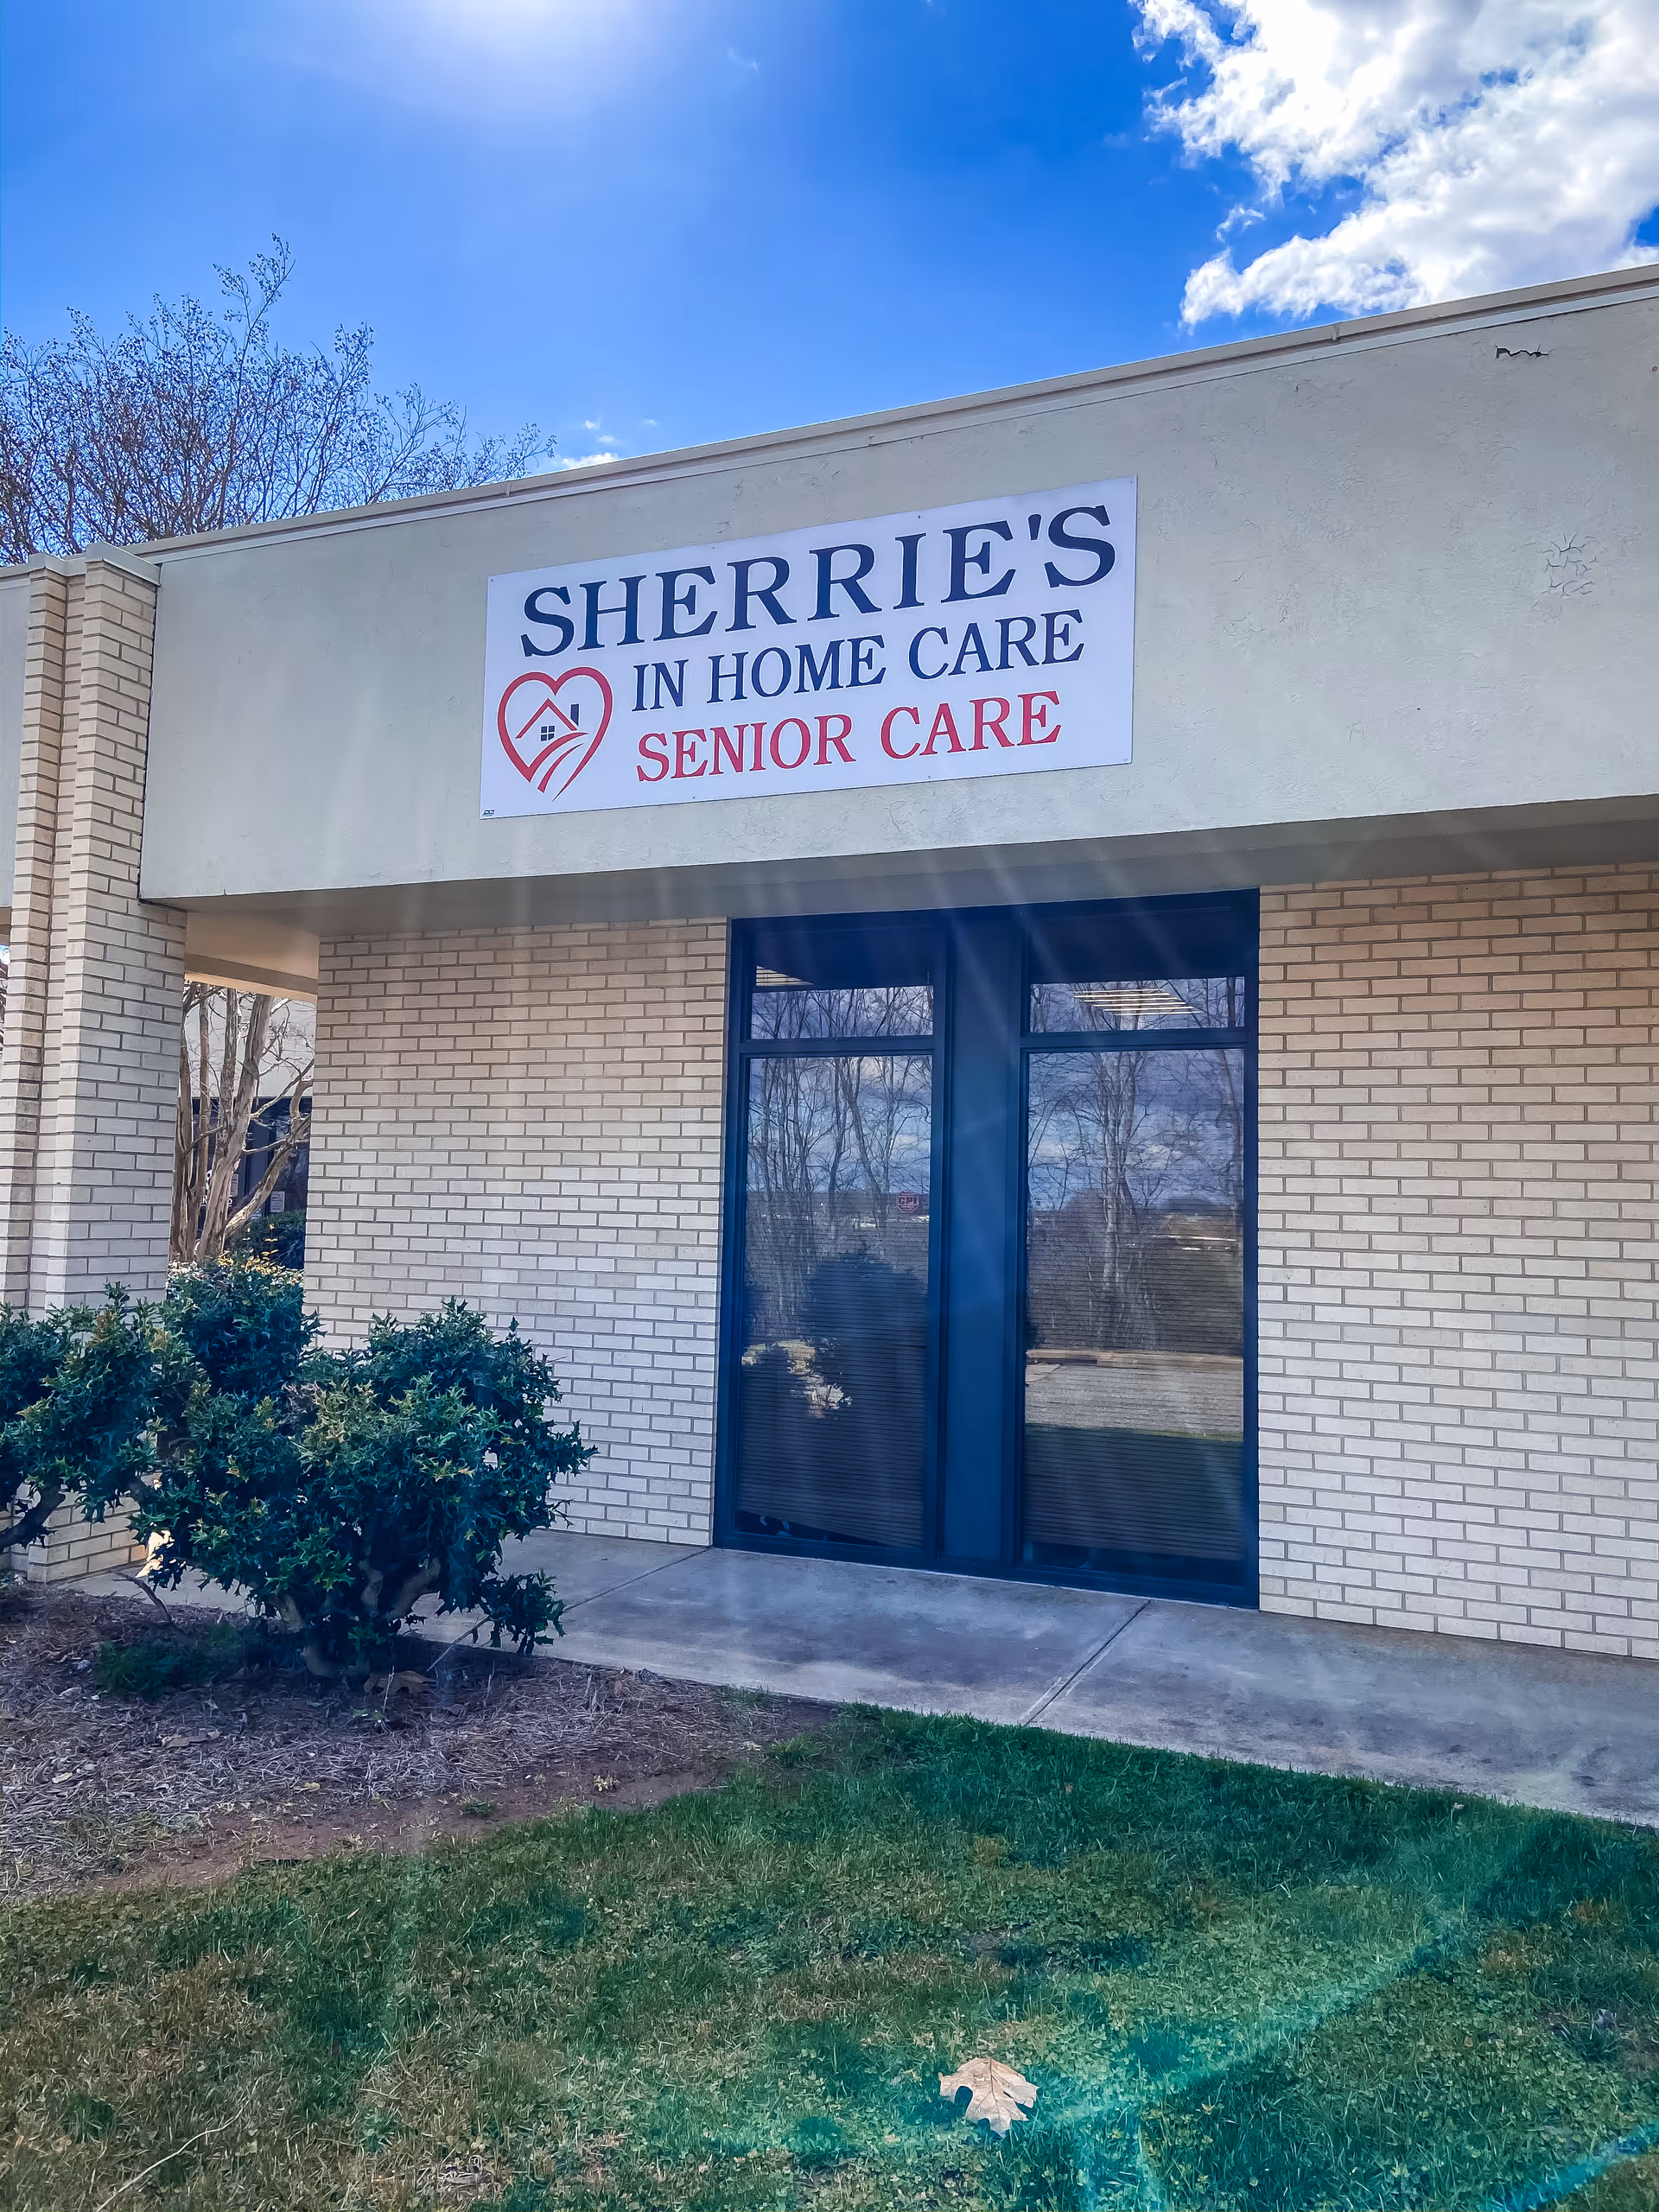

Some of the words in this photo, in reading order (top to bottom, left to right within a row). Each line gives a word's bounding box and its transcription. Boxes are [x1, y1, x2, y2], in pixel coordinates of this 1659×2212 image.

[520, 505, 1116, 658] SHERRIE'S
[632, 659, 690, 712] IN
[707, 634, 887, 704] HOME
[908, 608, 1085, 680] CARE
[637, 714, 856, 783] SENIOR
[880, 690, 1062, 760] CARE
